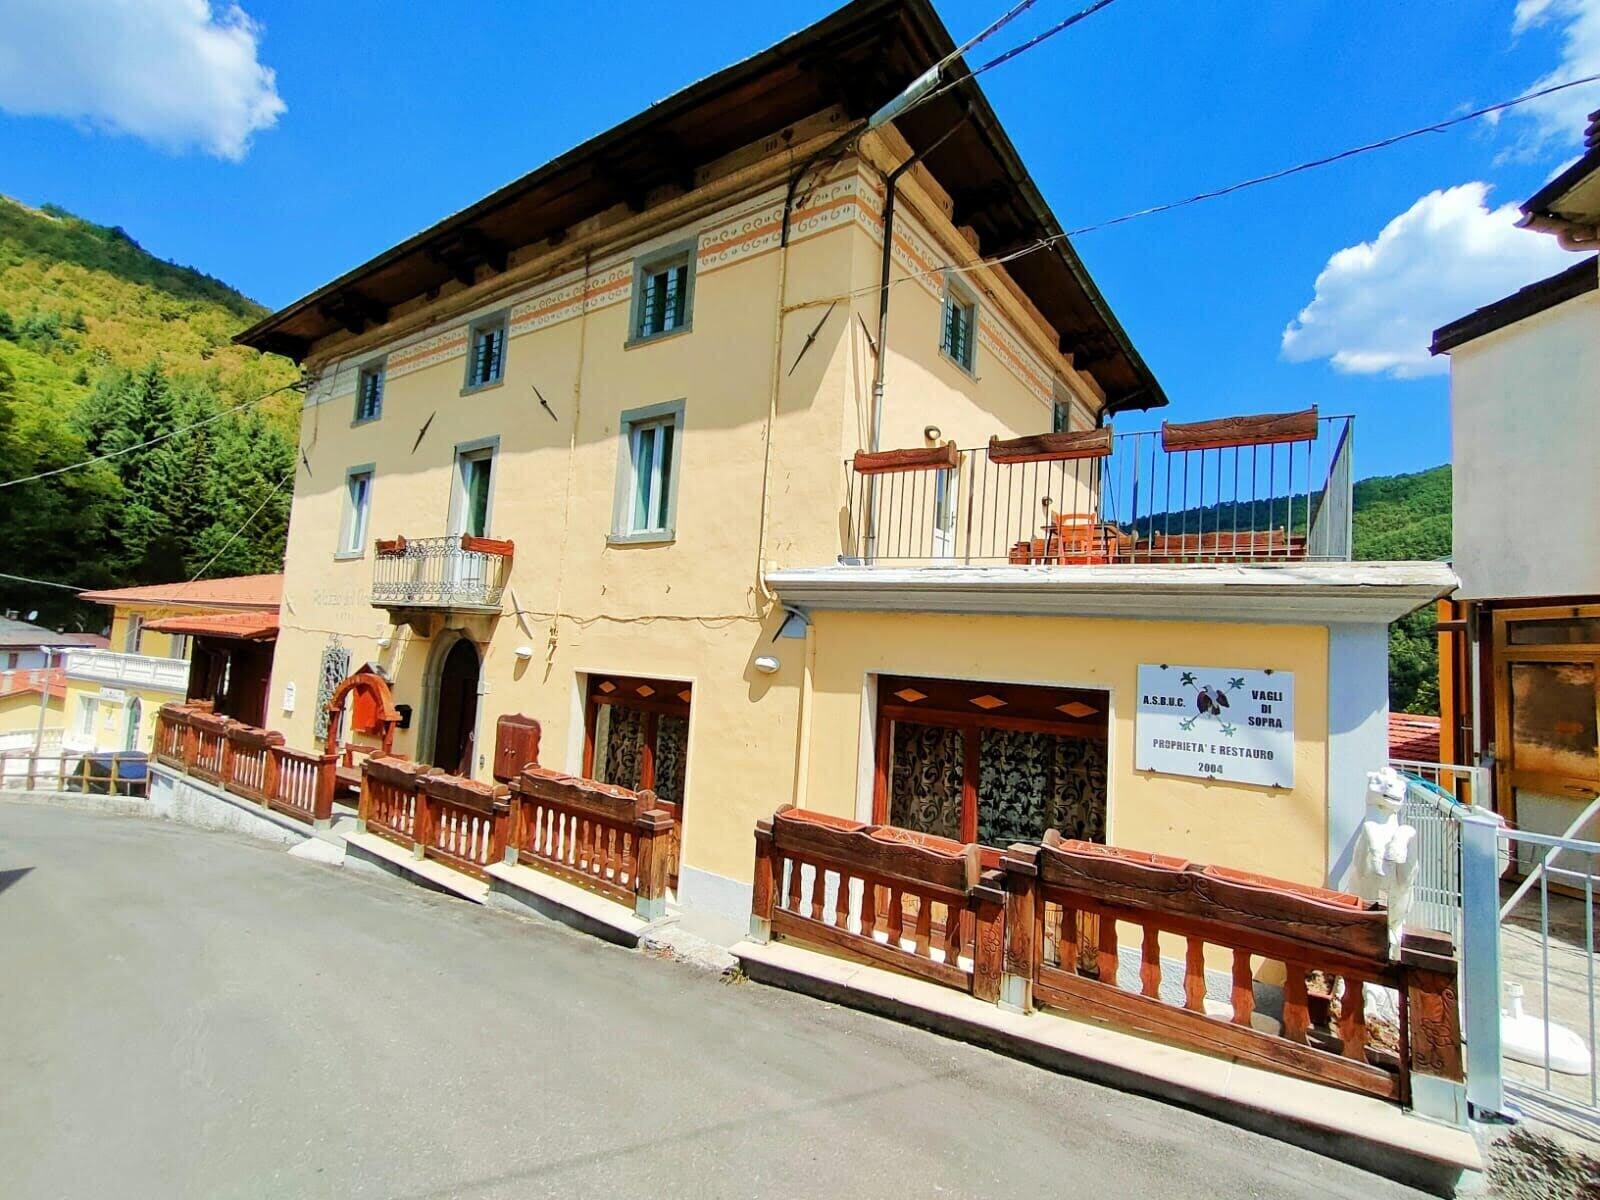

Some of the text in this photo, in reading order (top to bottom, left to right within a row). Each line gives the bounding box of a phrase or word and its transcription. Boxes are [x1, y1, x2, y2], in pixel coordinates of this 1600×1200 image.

[1143, 695, 1186, 708] A.S.B.U.C.
[1252, 689, 1283, 702] VAGLI
[1261, 704, 1272, 714] DI
[1248, 716, 1282, 728] SOPRA
[1211, 745, 1216, 754] E
[1219, 746, 1274, 760] RESTAURO
[1198, 762, 1223, 774] 2004
